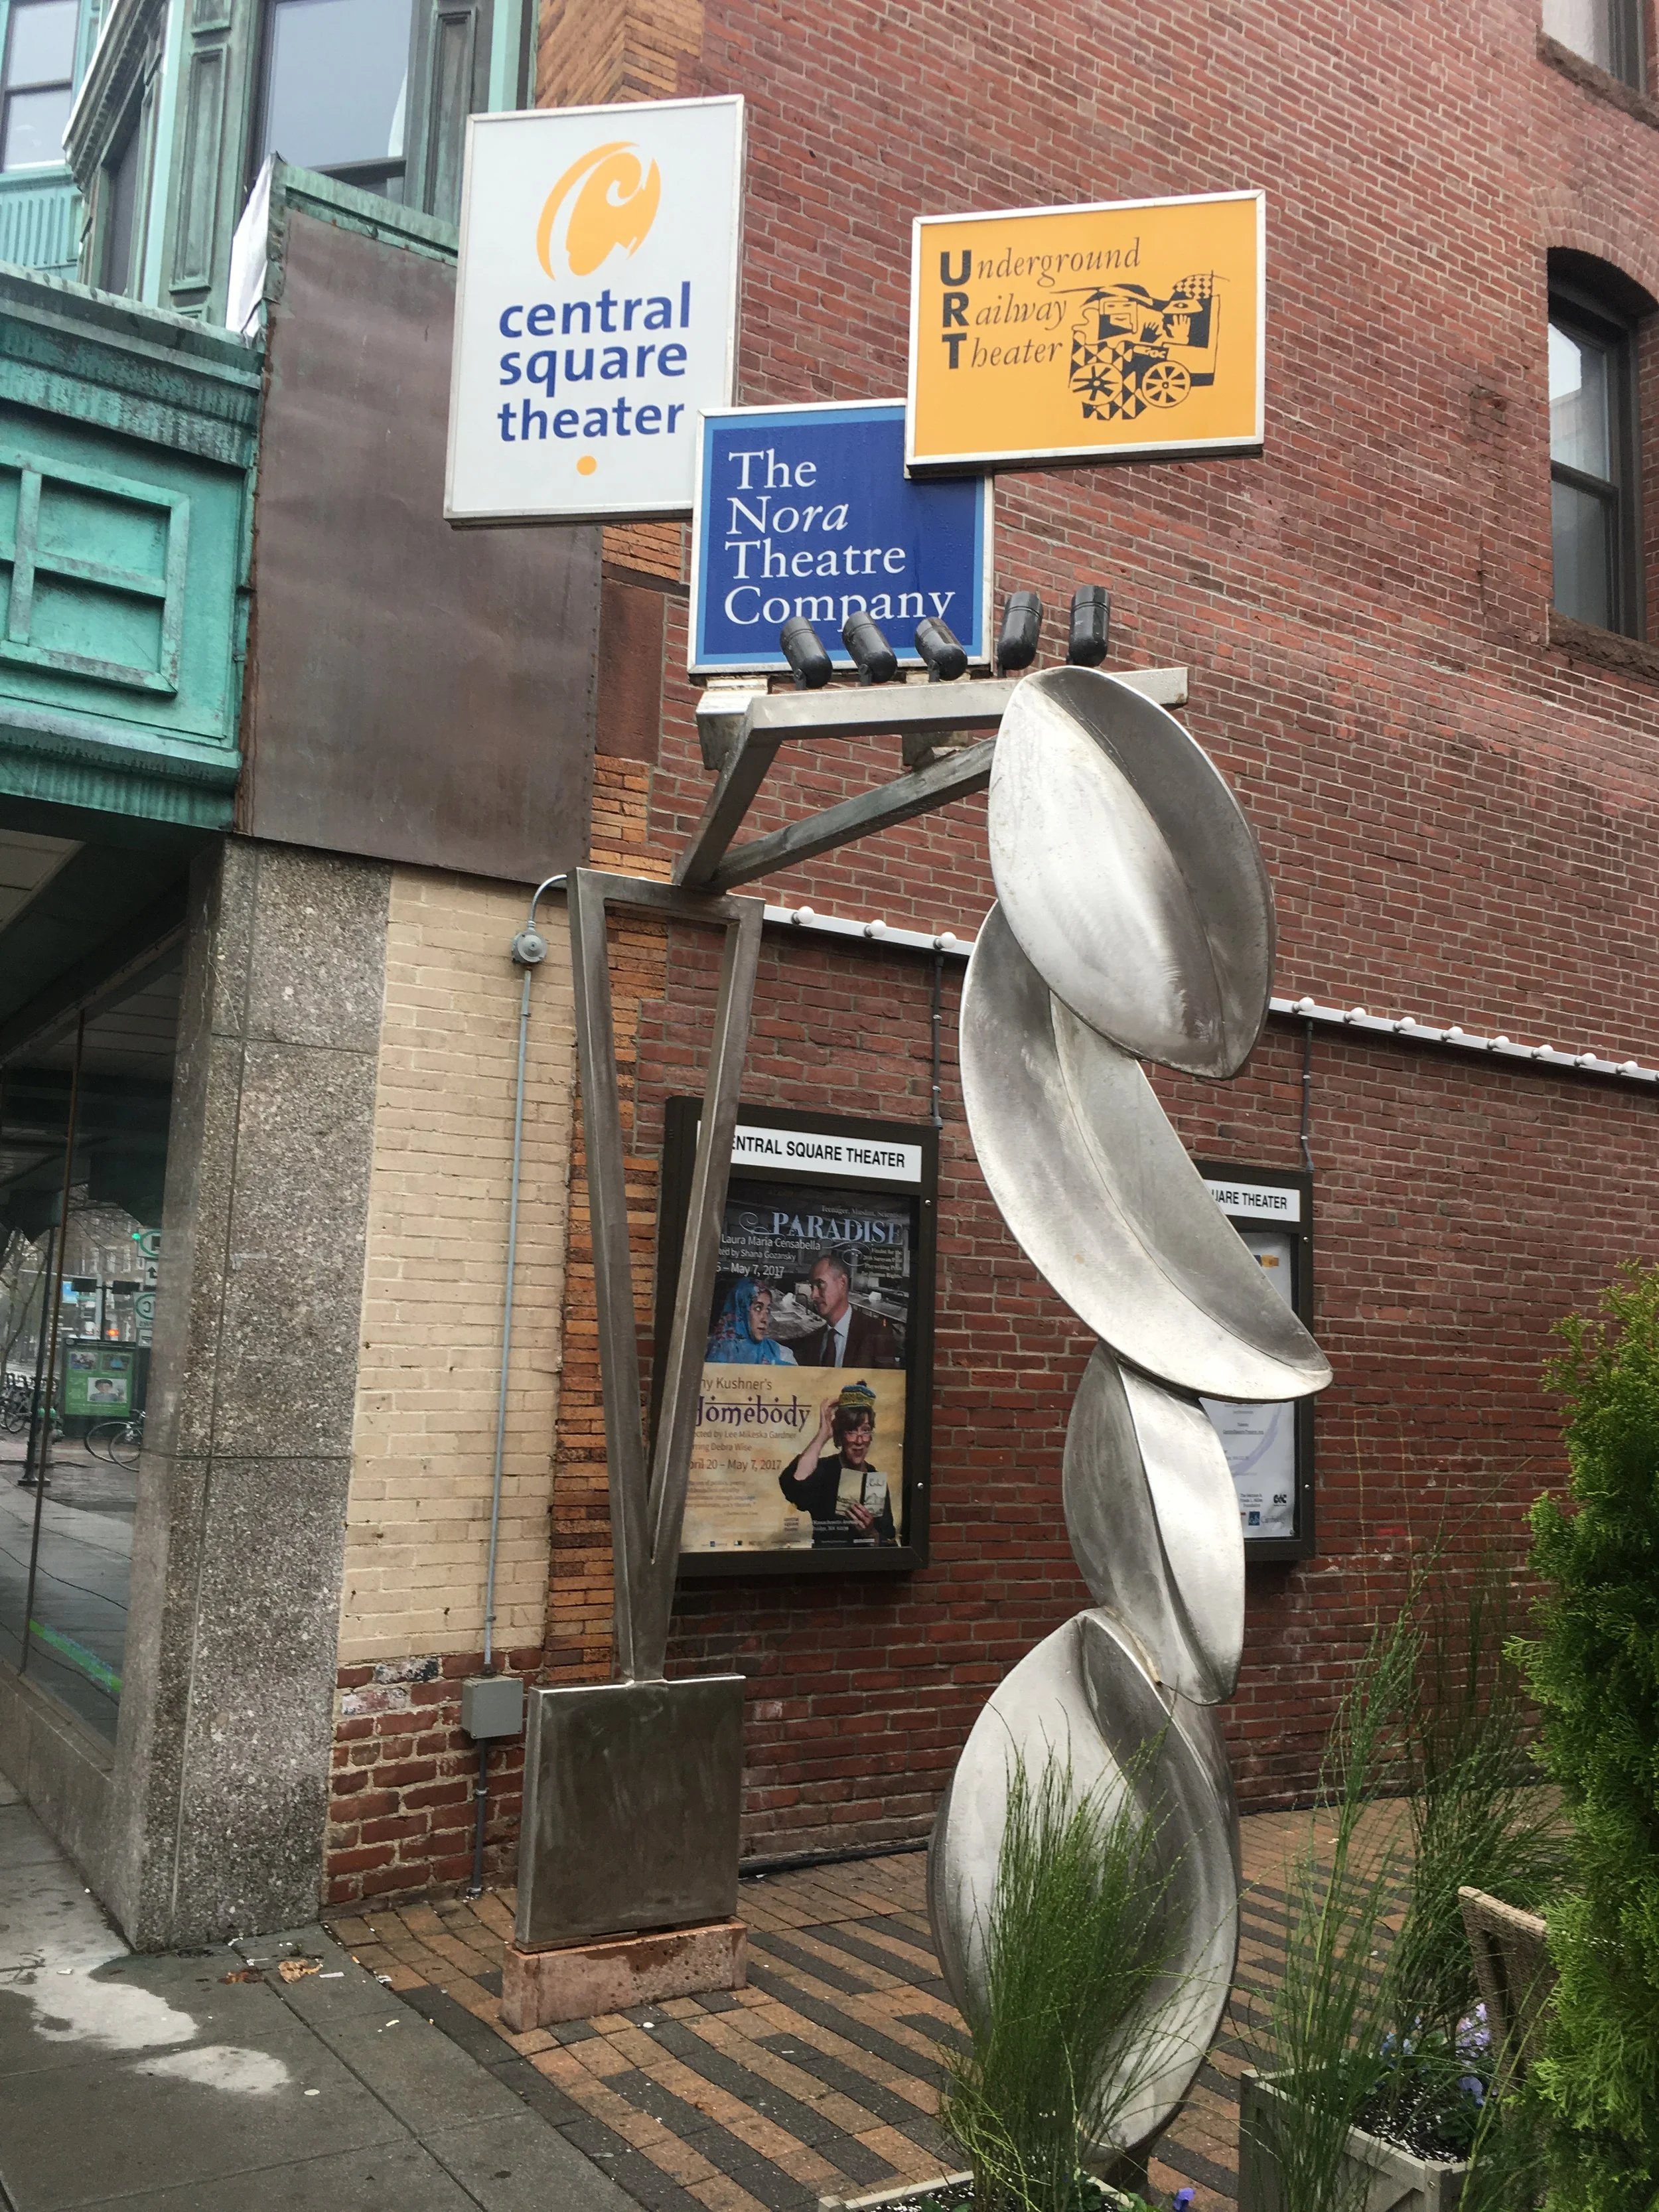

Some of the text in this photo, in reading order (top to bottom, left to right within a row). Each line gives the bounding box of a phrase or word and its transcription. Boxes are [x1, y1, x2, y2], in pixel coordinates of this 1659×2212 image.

[940, 237, 1141, 287] Underground
[500, 281, 690, 338] central
[942, 291, 1067, 331] Railway
[942, 332, 1063, 369] Theater
[500, 342, 687, 397] square
[498, 396, 684, 441] theater
[729, 448, 817, 489] The
[726, 496, 849, 534] Nora
[725, 538, 906, 579] Theatre
[725, 586, 956, 632] Company
[732, 1135, 905, 1168] NTRAL SQUARE THEATER
[1212, 1189, 1287, 1209] UARE THEATER
[721, 1234, 821, 1251] Laura Maria Censabella
[772, 1212, 903, 1246] PARADISE
[731, 1248, 740, 1258] by
[731, 1262, 751, 1278] May
[763, 1265, 784, 1277] 2017
[701, 1377, 772, 1391] ny Kushner's
[707, 1459, 717, 1470] 20
[727, 1459, 749, 1473] May
[760, 1459, 781, 1470] 2017
